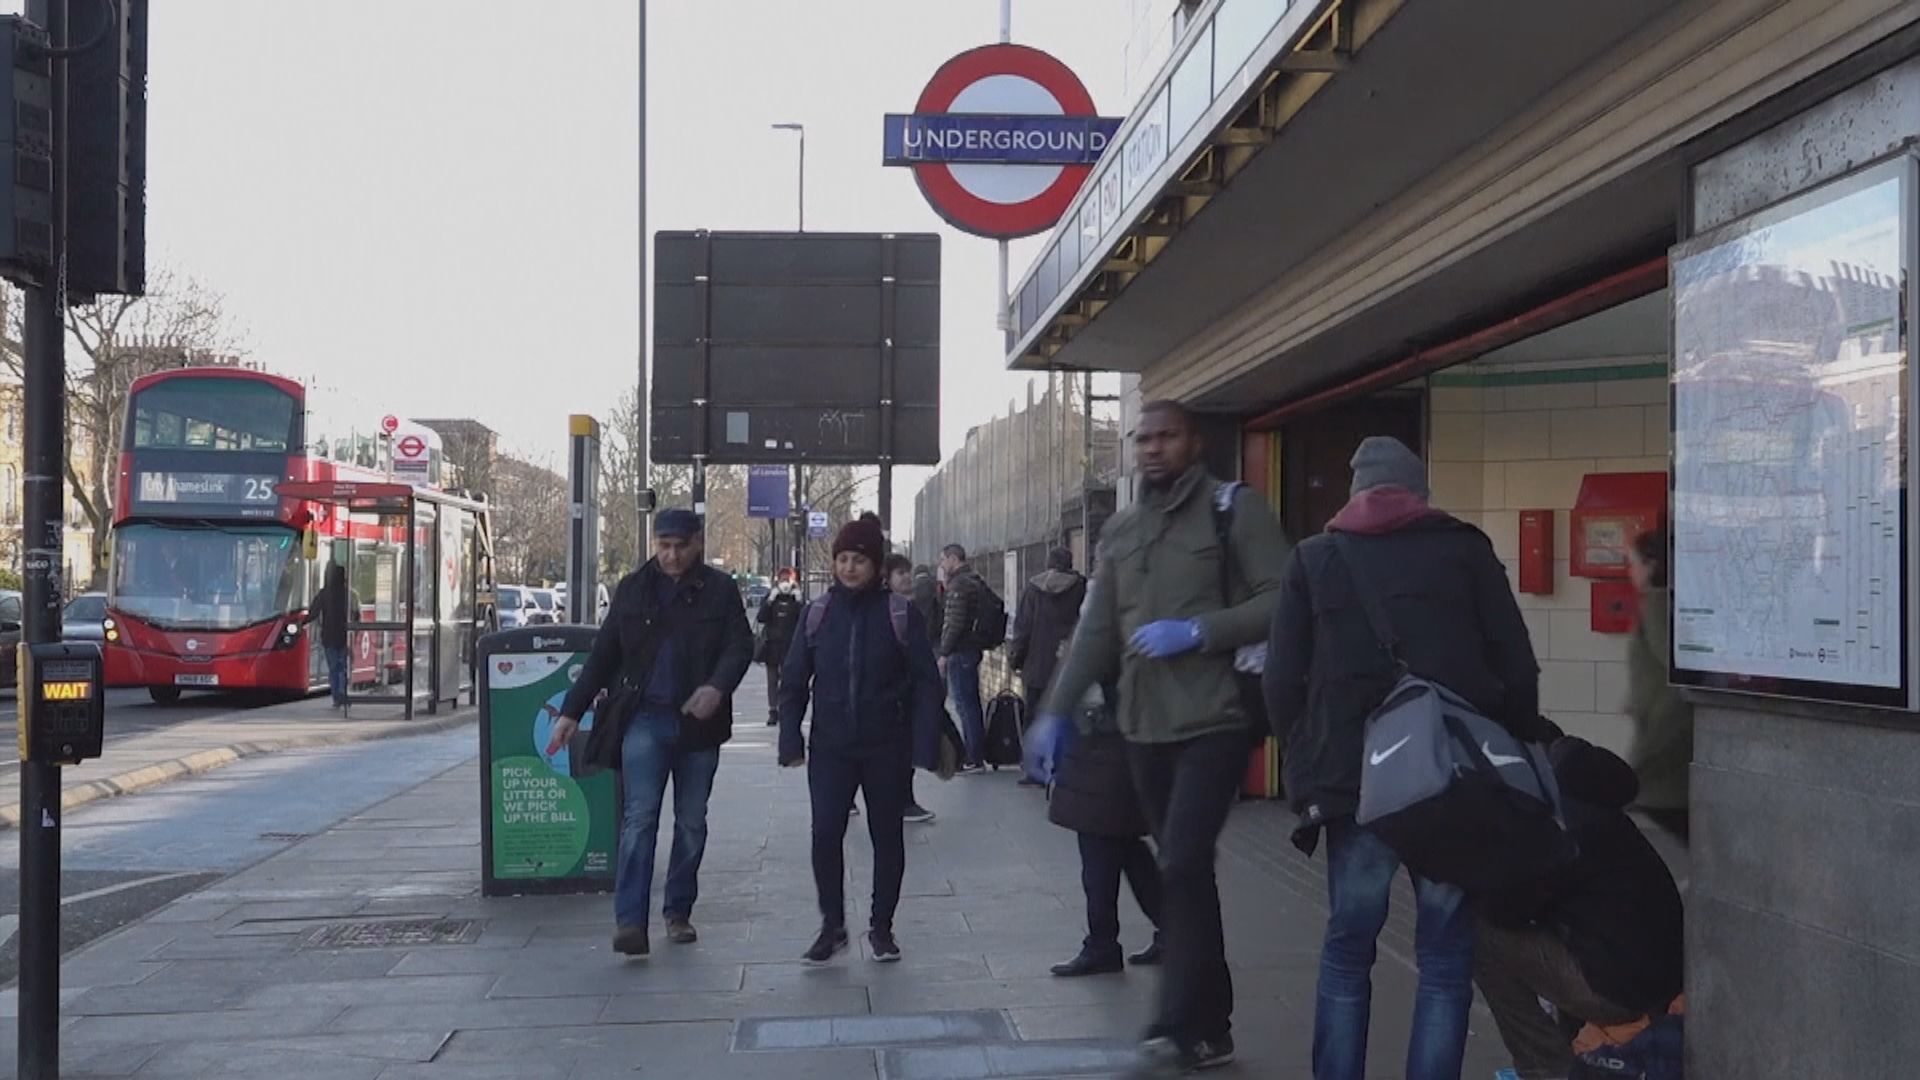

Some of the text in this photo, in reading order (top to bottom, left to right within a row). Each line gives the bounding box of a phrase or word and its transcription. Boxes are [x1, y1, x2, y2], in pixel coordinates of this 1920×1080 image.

[904, 129, 1106, 150] UNDERGROUND
[145, 477, 165, 495] City
[244, 478, 272, 500] 25
[43, 682, 89, 699] WAIT
[502, 767, 532, 778] PICK
[502, 778, 558, 790] UP YOUR
[503, 789, 567, 801] LITTER OR
[503, 800, 557, 812] WE PICK
[503, 811, 577, 824] UP THE BILL
